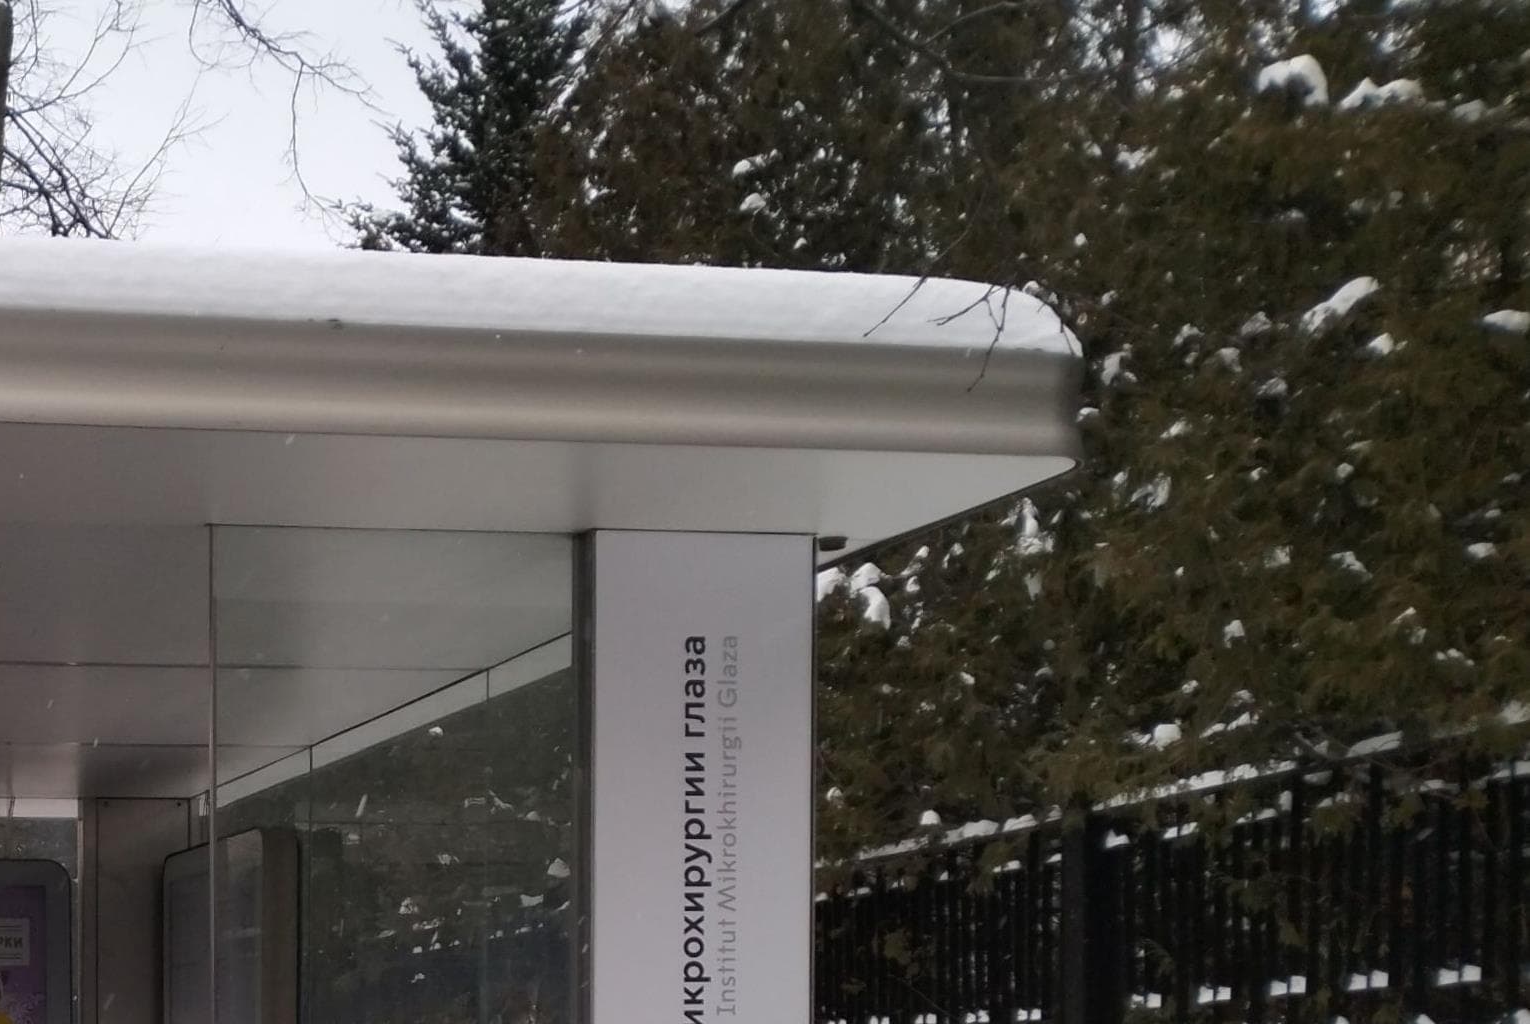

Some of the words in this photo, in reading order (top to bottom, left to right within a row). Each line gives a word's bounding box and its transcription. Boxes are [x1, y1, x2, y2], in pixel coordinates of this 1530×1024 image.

[684, 635, 706, 737] глаза
[716, 635, 738, 707] Glaza
[716, 717, 742, 911] Mikrokhirurgii
[716, 918, 737, 1016] Institut
